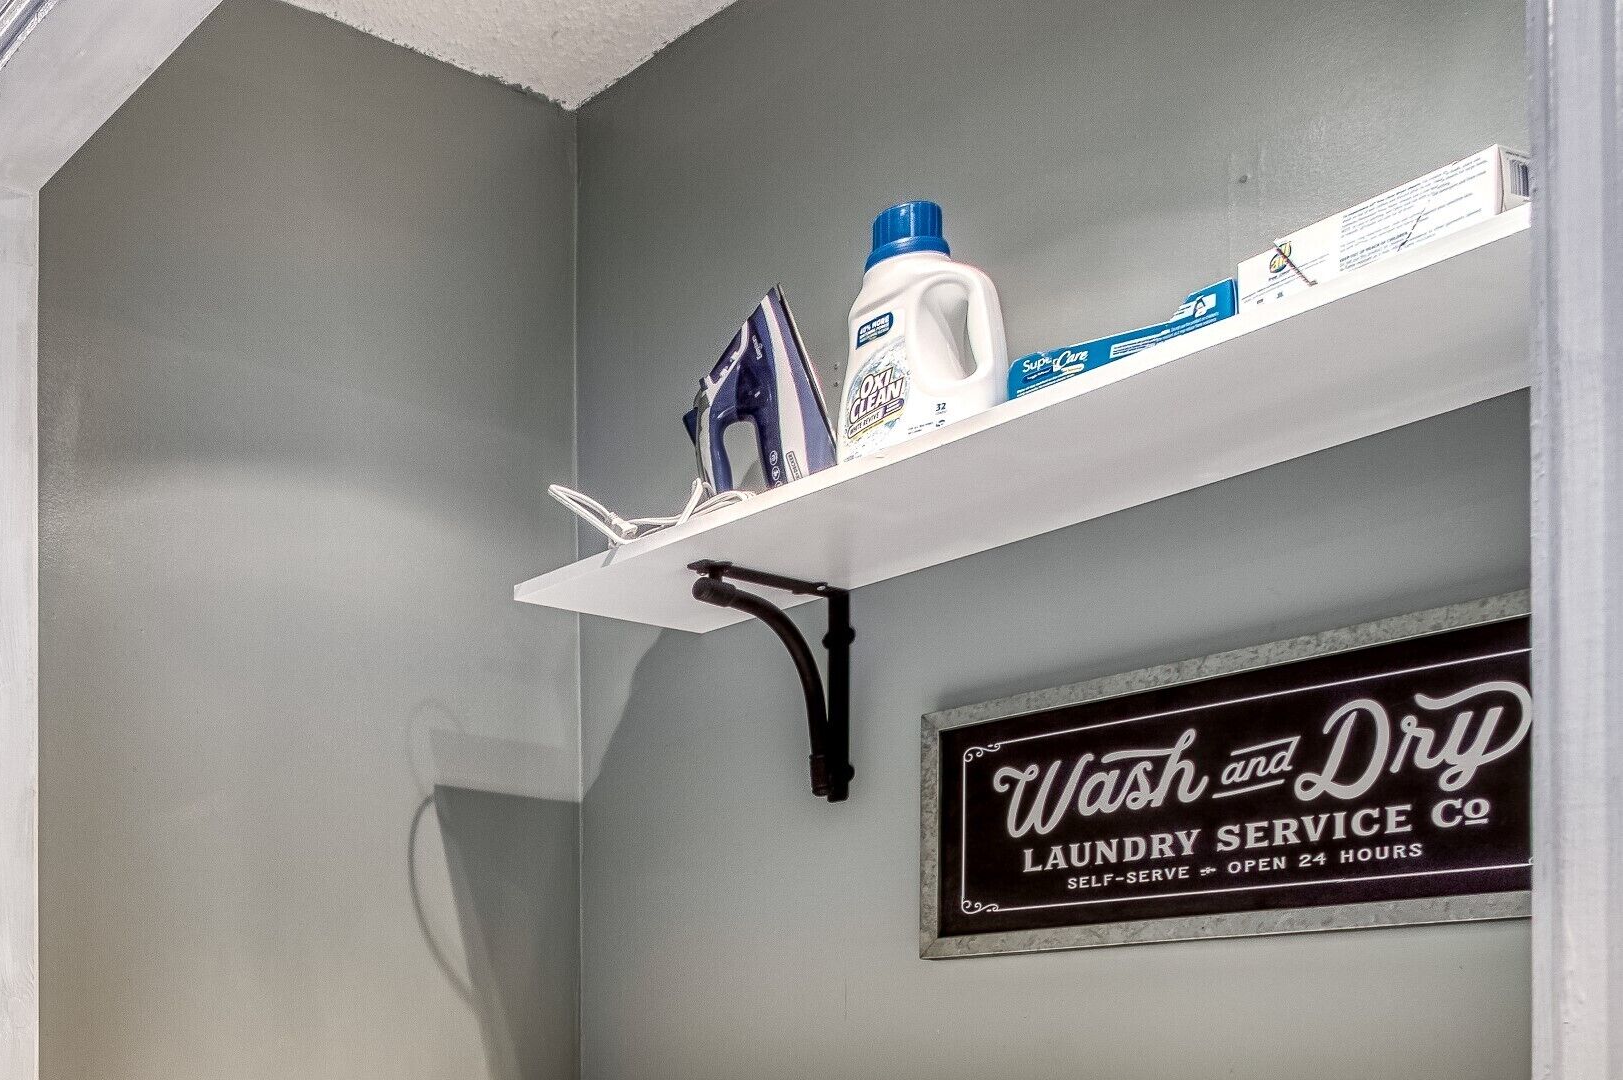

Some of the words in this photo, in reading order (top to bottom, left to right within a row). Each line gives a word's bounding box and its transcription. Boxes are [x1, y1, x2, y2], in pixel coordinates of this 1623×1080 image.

[849, 376, 904, 425] CLEAN
[859, 367, 894, 400] OXI
[935, 402, 947, 412] 32
[993, 728, 1209, 838] Wash
[1220, 735, 1301, 785] and
[1294, 681, 1532, 801] Dry
[1022, 828, 1202, 874] LAUNDRY
[1216, 804, 1413, 852] SERVICE
[1067, 866, 1190, 890] SELF-SERVE
[1227, 857, 1287, 874] OPEN
[1298, 852, 1327, 868] 24
[1340, 843, 1423, 864] HOURS
